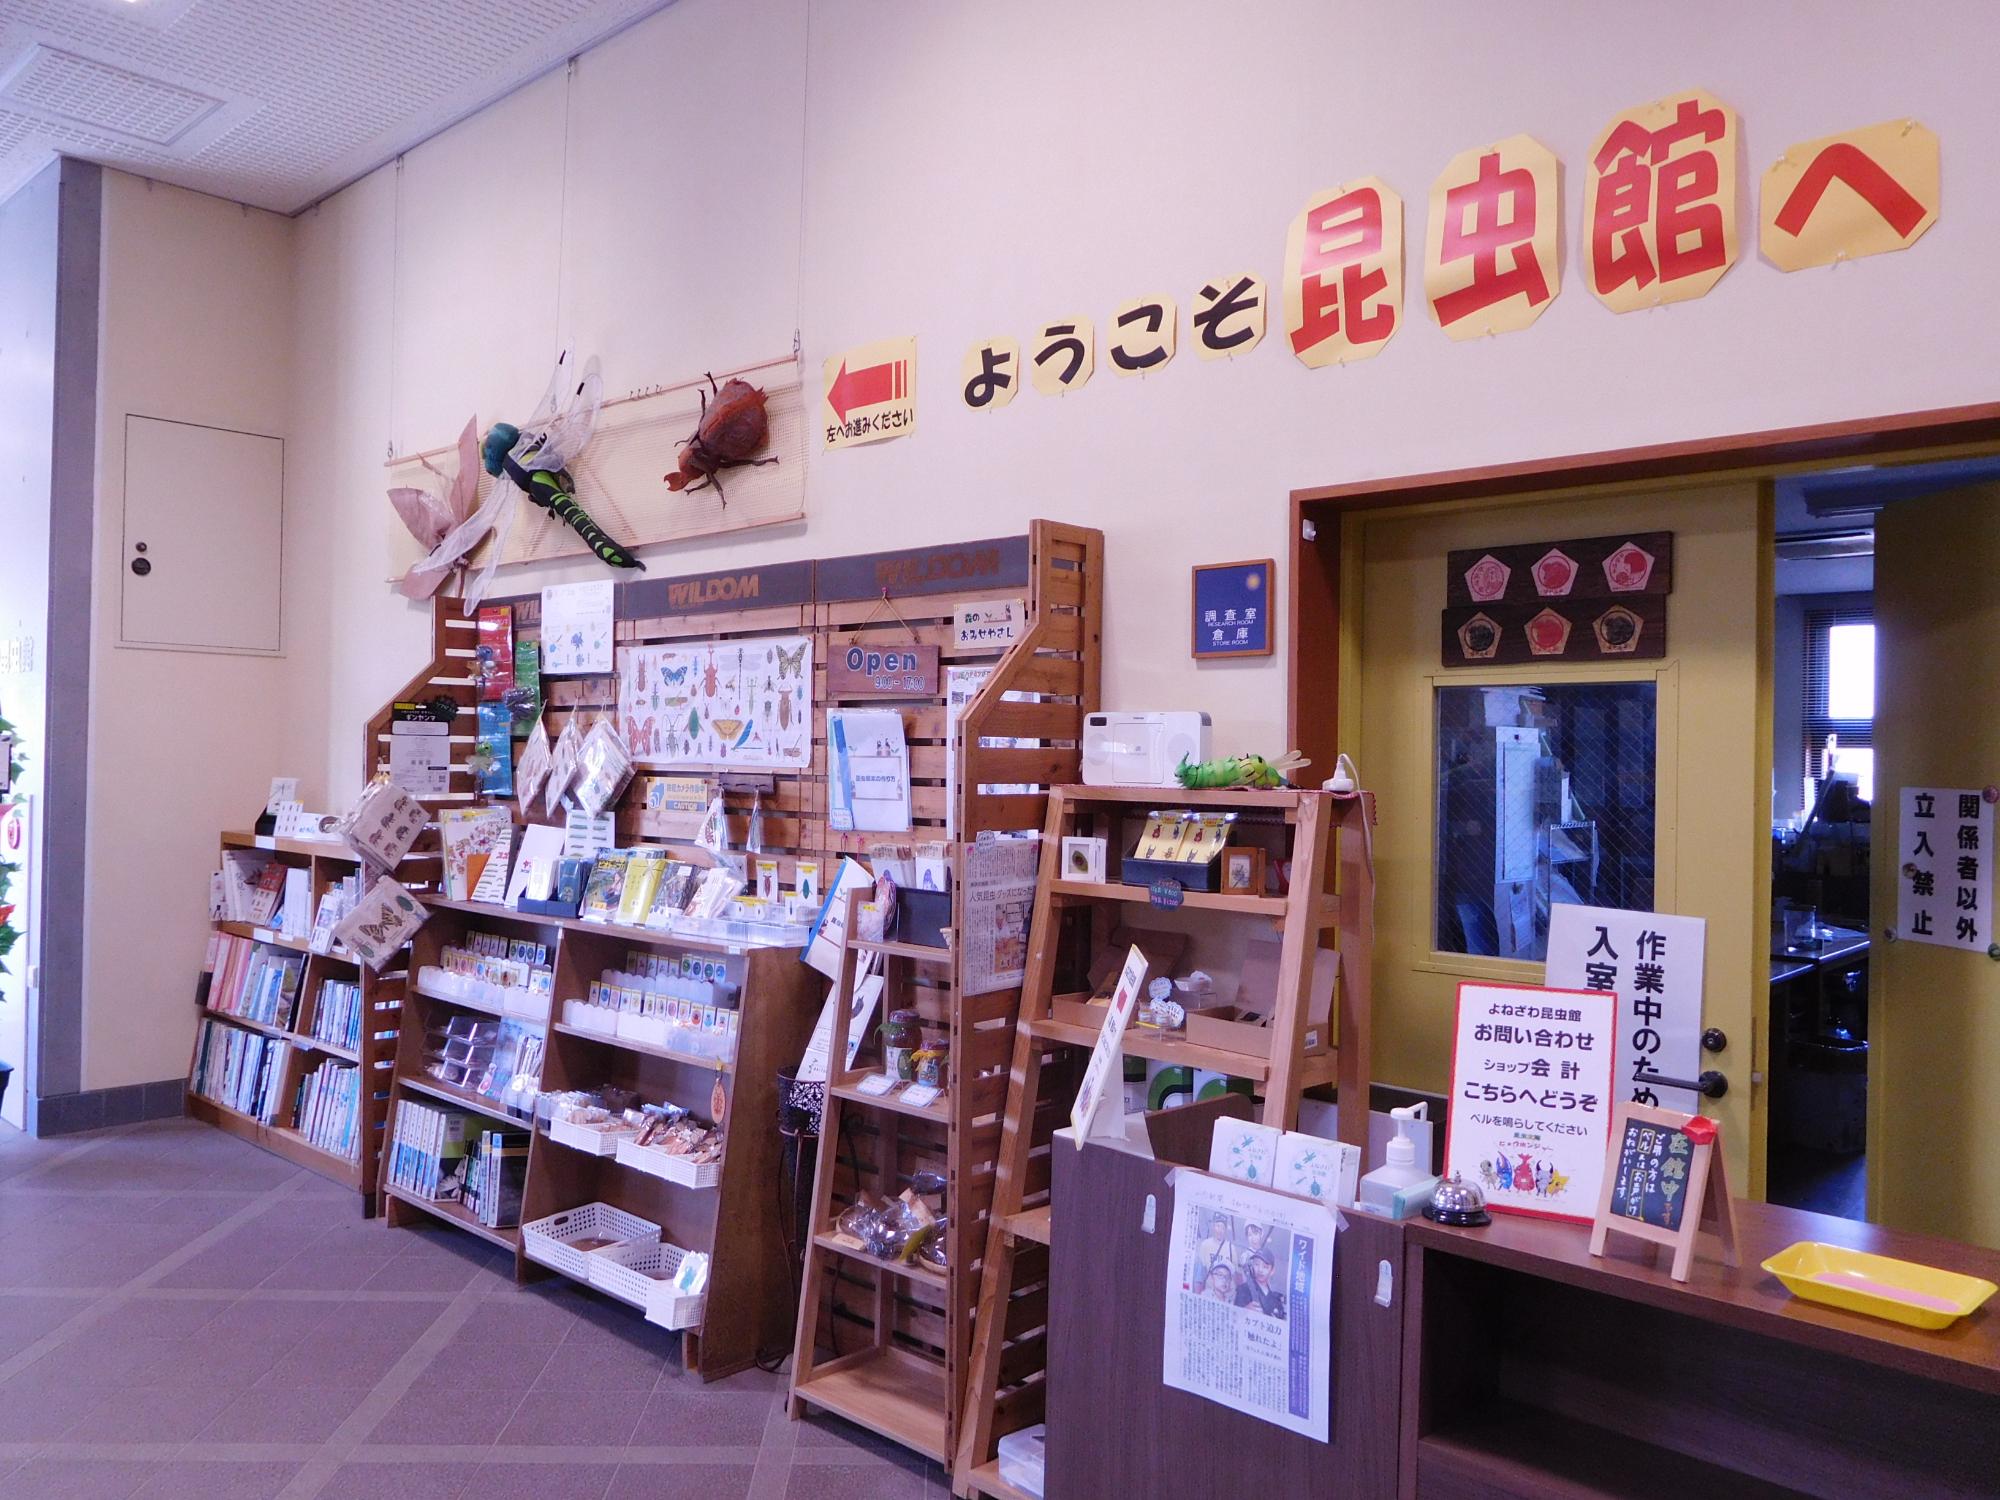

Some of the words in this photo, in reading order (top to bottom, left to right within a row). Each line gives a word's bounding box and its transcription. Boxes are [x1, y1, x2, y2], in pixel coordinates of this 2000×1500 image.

[963, 277, 1258, 408] ようこそ
[1291, 98, 1928, 357] 昆虫館へ
[826, 408, 914, 443] 左へお進みください
[668, 574, 760, 607] WILDOM
[1204, 608, 1257, 623] 調査室
[960, 626, 1014, 641] おみせやさん
[846, 646, 918, 677] Open
[1911, 792, 1936, 937] 立入禁止
[1955, 794, 1981, 943] 関係者以外
[1488, 1003, 1582, 1022] よねざわ昆虫館
[1631, 930, 1667, 1109] 作業中のため
[1474, 1023, 1594, 1051] お問い合わせ
[1464, 1081, 1599, 1113] こちらへどうぞ
[1470, 1113, 1588, 1136] ベルを鳴らしてください
